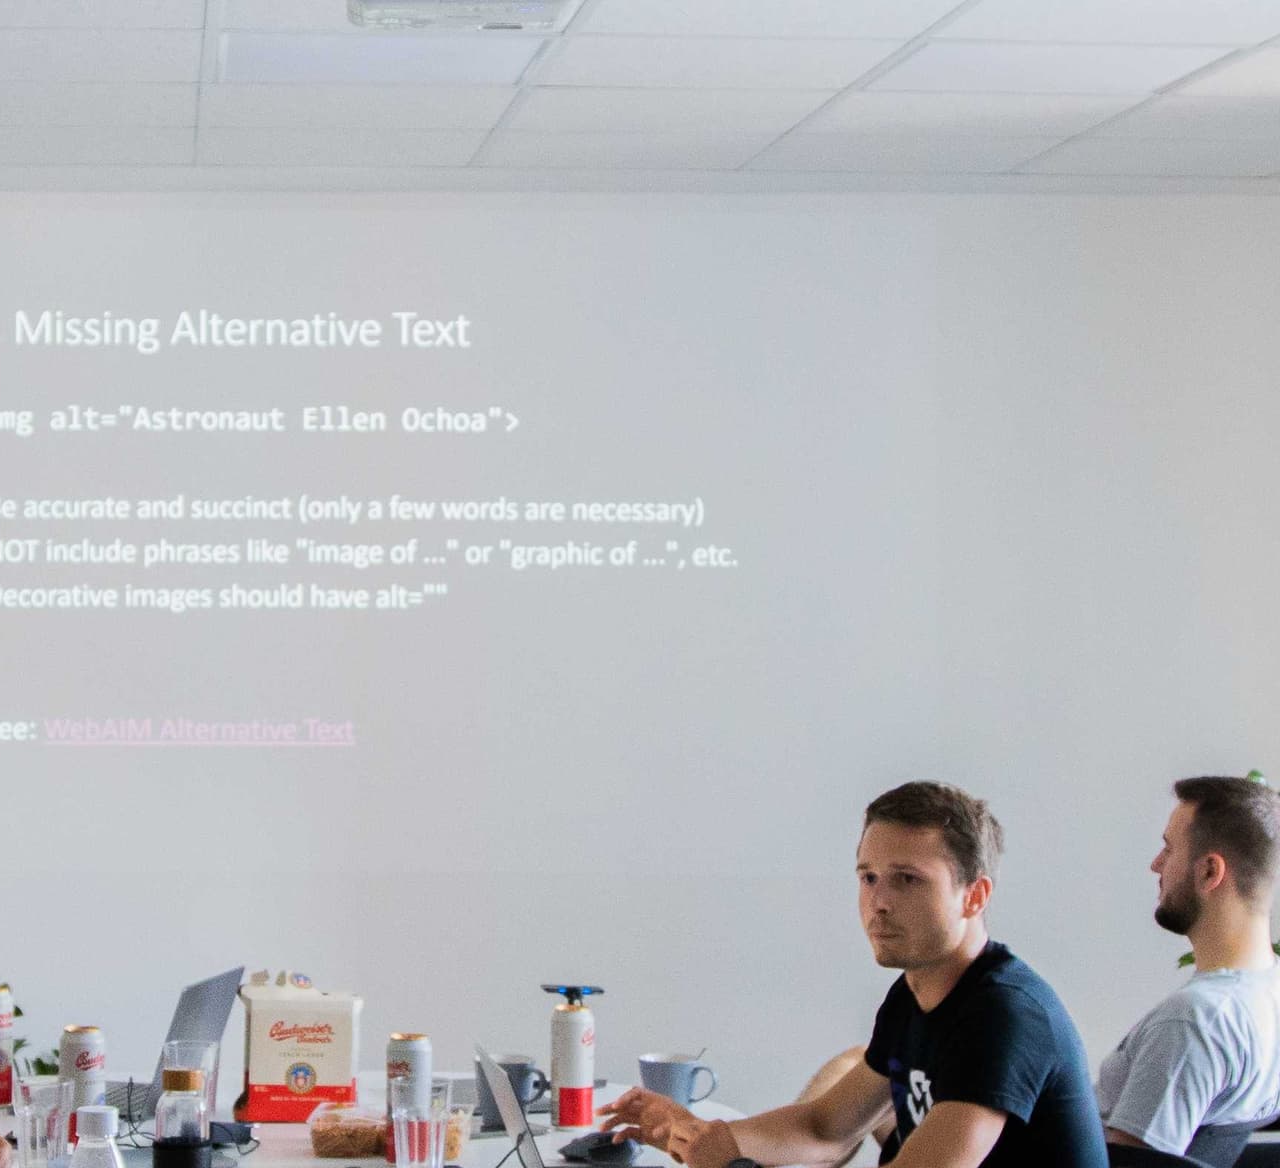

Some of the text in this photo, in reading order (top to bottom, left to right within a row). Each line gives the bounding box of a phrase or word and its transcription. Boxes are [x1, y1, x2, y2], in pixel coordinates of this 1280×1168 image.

[15, 310, 161, 355] Missing
[170, 309, 383, 347] Alternative
[391, 311, 472, 347] Text
[50, 405, 286, 432] alt="Astronaut
[303, 405, 388, 433] Ellen
[401, 407, 520, 433] Ochoa">
[23, 497, 131, 520] accurate
[136, 495, 185, 520] and
[191, 496, 292, 520] succinct
[299, 494, 362, 524] (only
[367, 501, 383, 520] a
[389, 495, 436, 521] few
[441, 497, 519, 521] words
[524, 502, 566, 521] are
[572, 497, 705, 527] necessary)
[46, 538, 137, 564] include
[144, 538, 241, 568] phrases
[247, 538, 290, 564] like
[296, 539, 385, 569] "image
[390, 538, 419, 564] of
[465, 545, 494, 565] or
[499, 539, 604, 570] "graphic
[609, 540, 638, 566] of
[692, 545, 739, 568] etc.
[125, 584, 212, 613] images
[219, 583, 303, 609] should
[310, 584, 369, 609] have
[375, 583, 448, 610] alt=""
[44, 718, 152, 743] WebAIM
[159, 717, 297, 743] Alternative
[304, 718, 355, 744] Text
